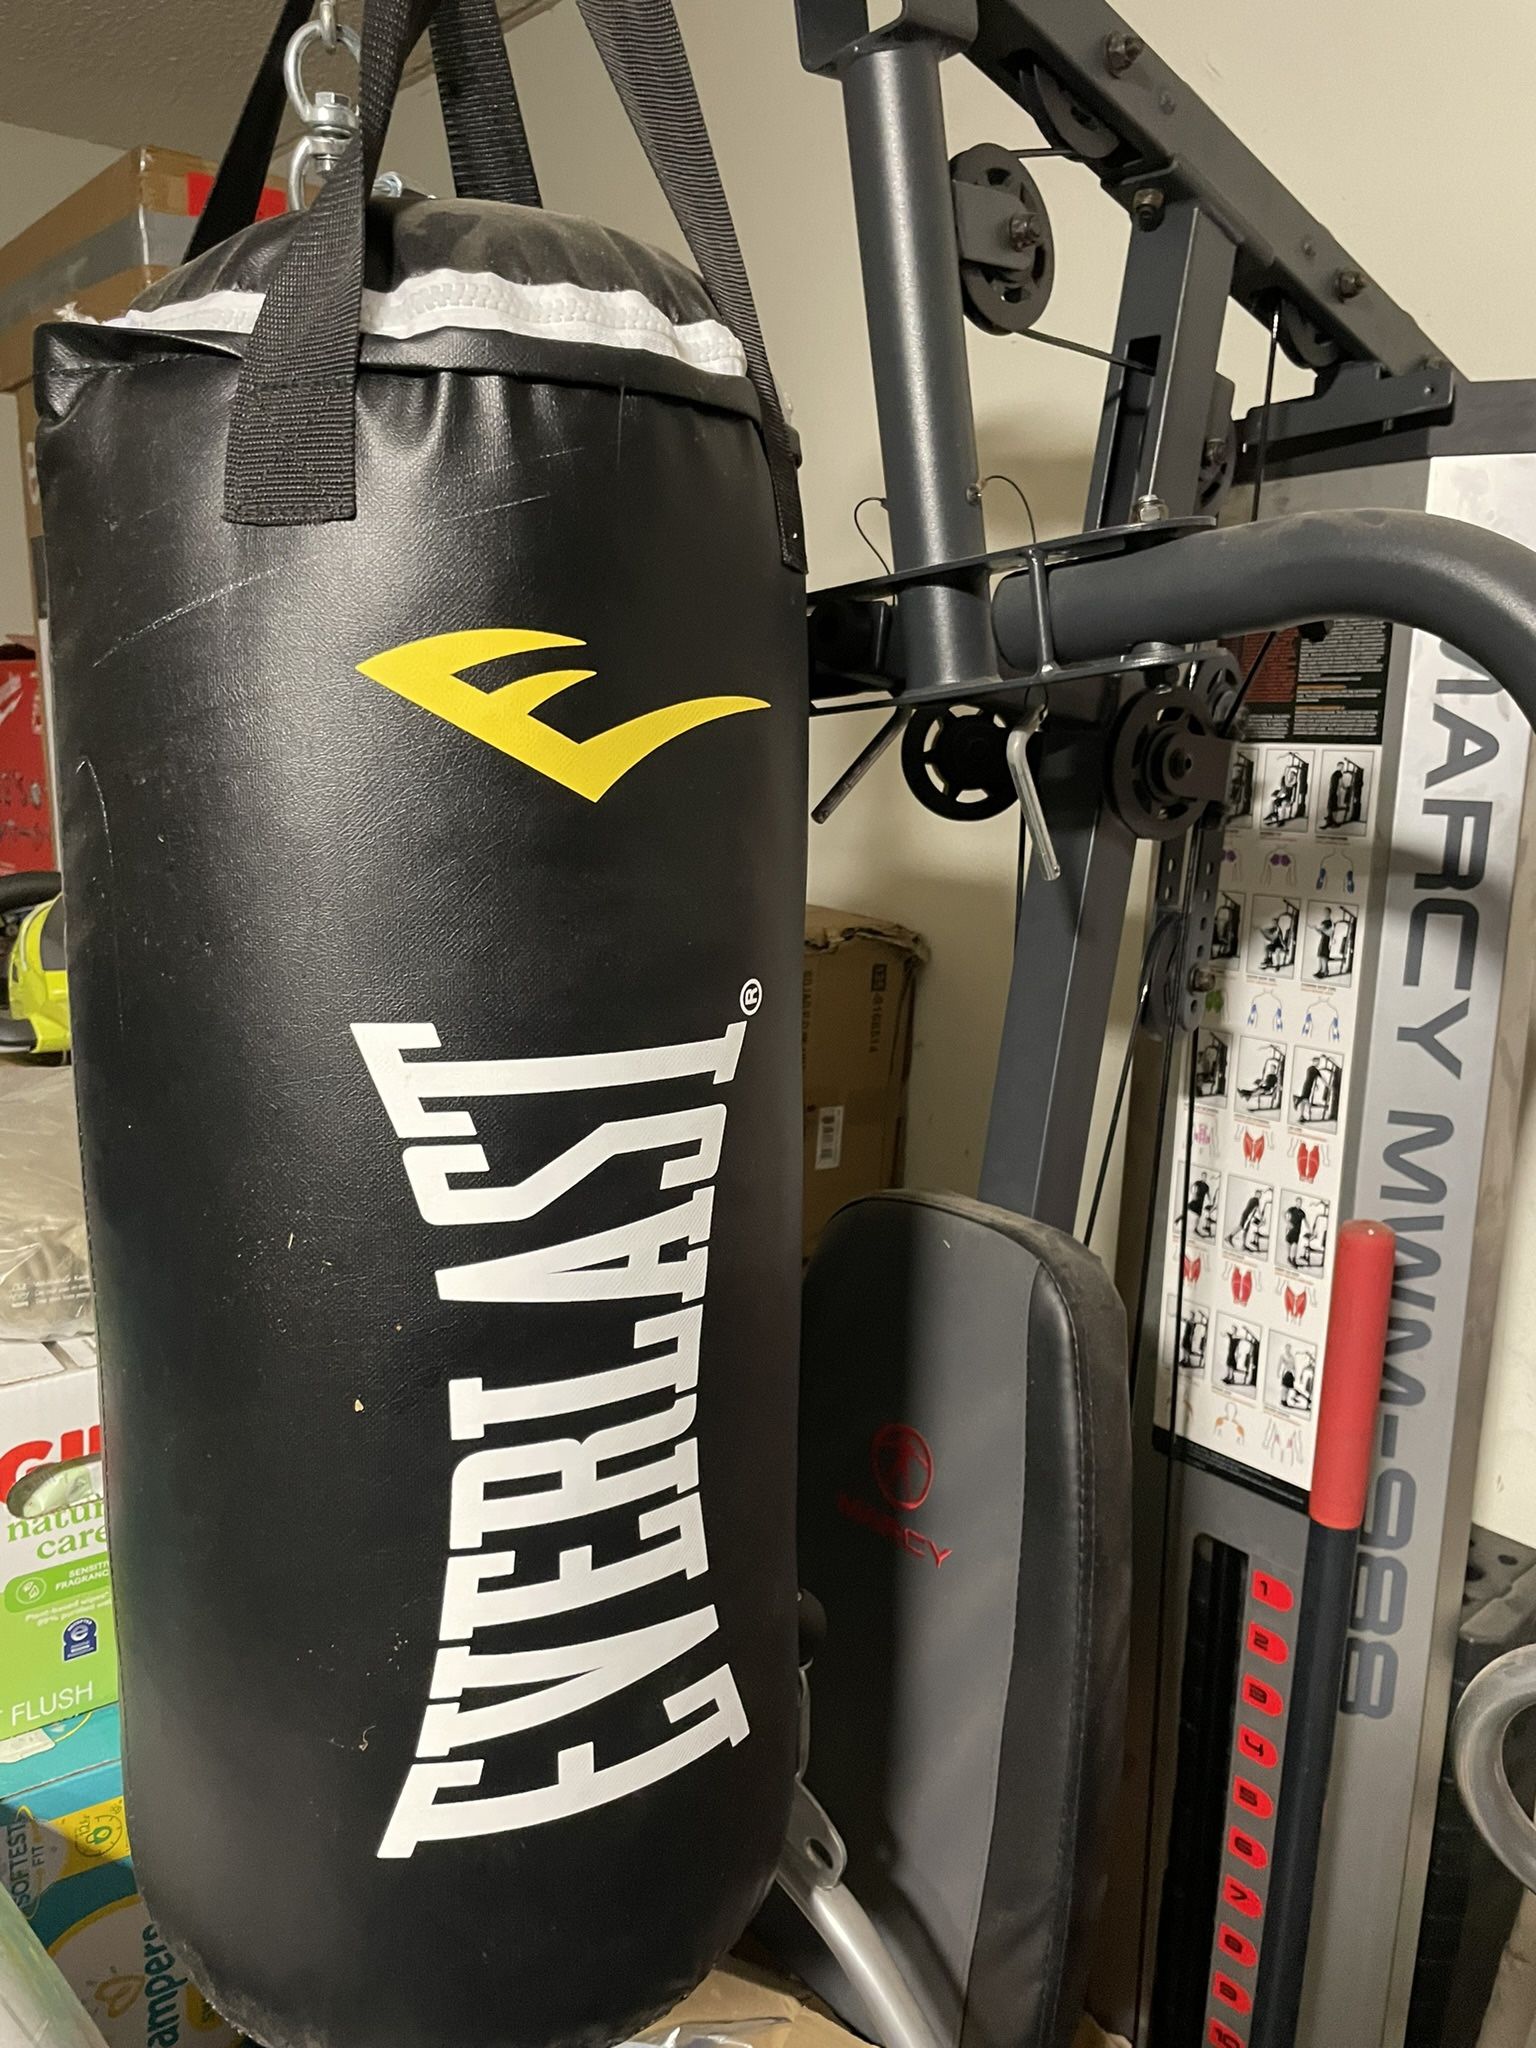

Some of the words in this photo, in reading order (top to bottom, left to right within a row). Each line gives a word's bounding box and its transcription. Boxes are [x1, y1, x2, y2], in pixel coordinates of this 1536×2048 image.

[350, 1021, 751, 1859] EVERLAST
[36, 1524, 107, 1559] care
[11, 1680, 93, 1726] FLUSH
[31, 1845, 45, 1867] FIT
